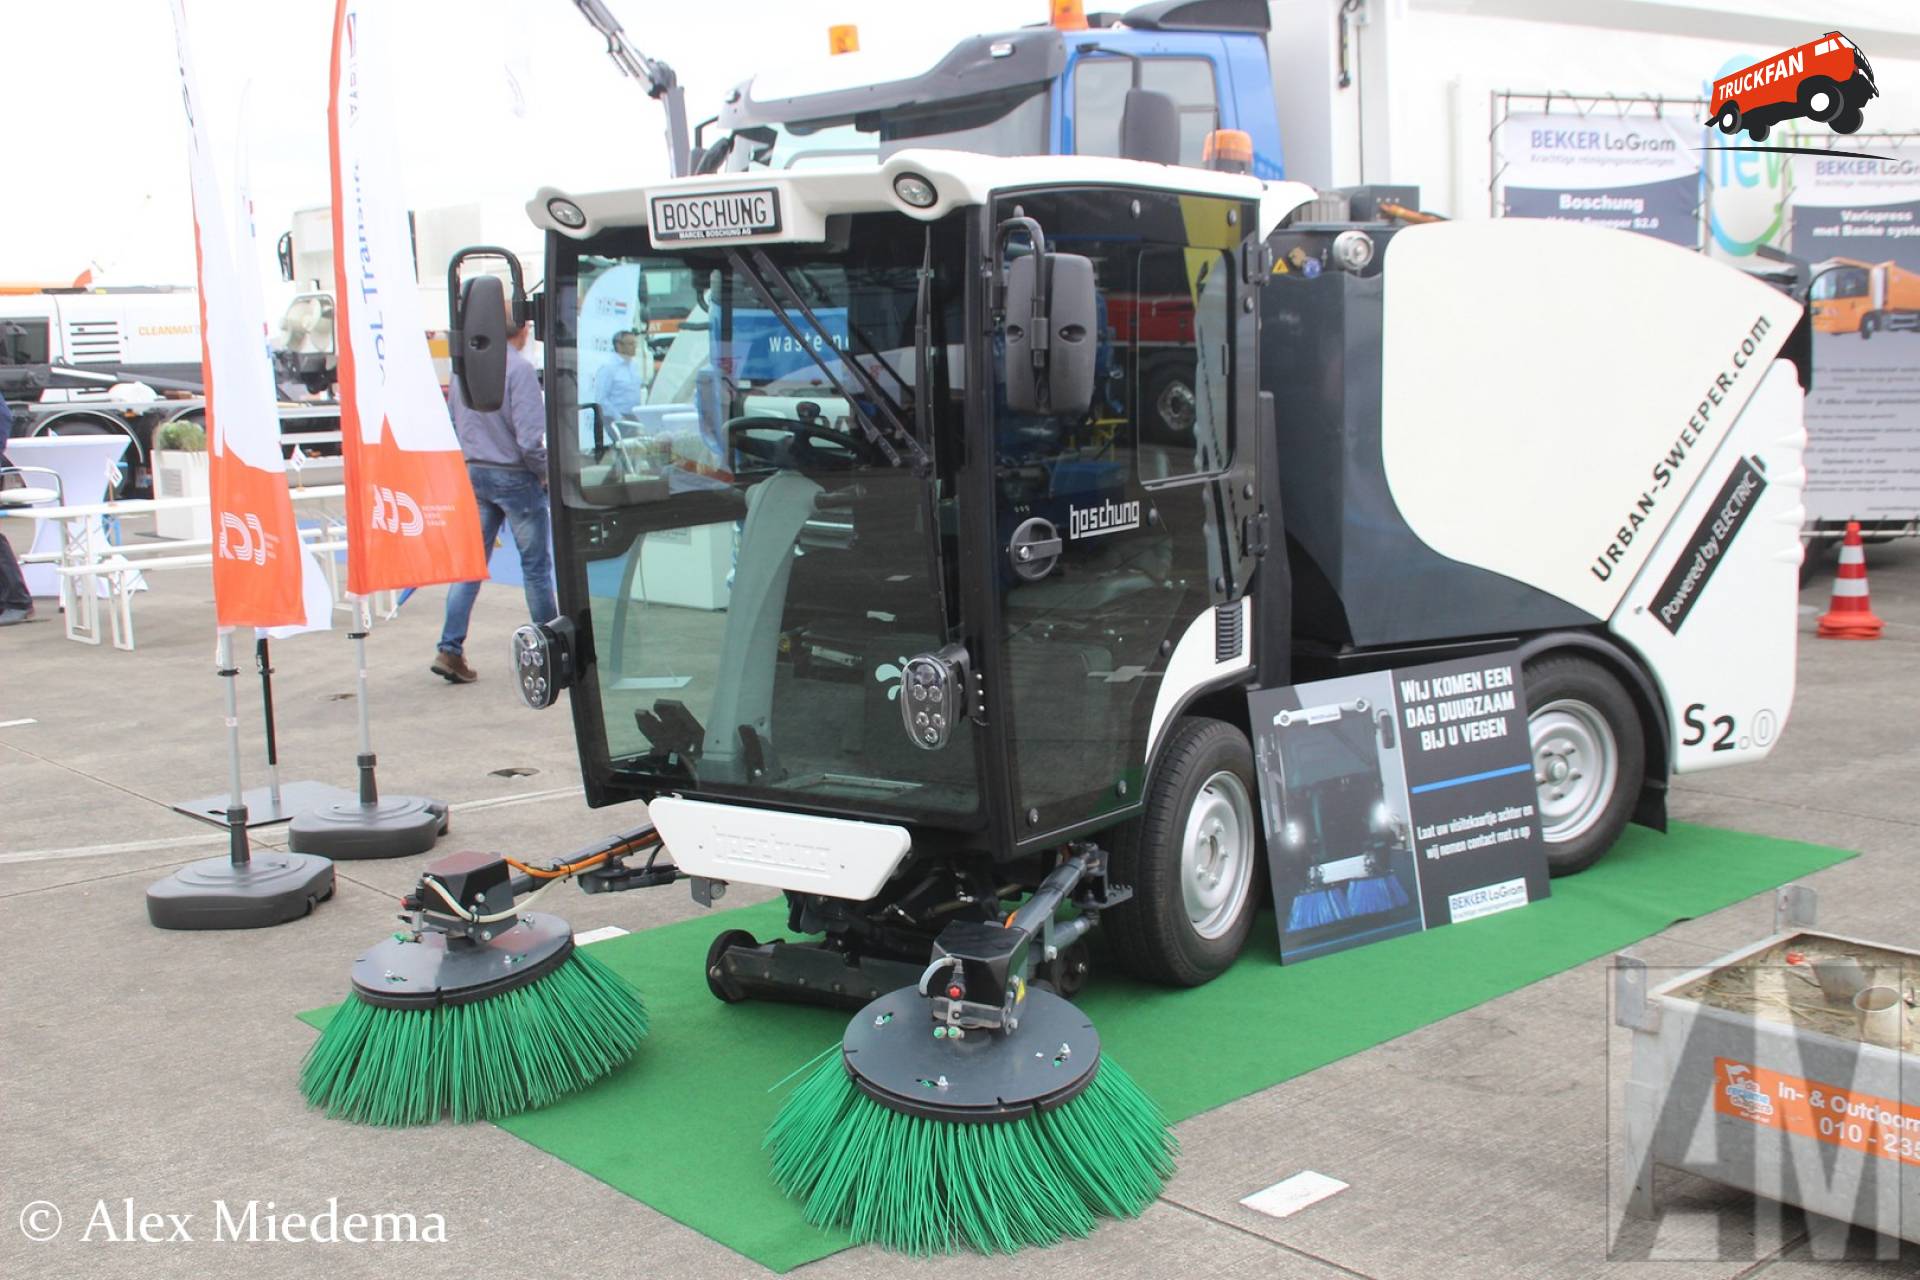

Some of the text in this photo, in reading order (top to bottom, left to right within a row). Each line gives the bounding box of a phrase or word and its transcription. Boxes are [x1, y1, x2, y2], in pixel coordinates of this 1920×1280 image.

[1605, 132, 1676, 152] LaGram
[663, 197, 767, 231] BOSCHUNG
[1559, 193, 1645, 214] Boschung
[705, 228, 741, 238] BOSCHUNG
[1632, 217, 1660, 229] S2.0
[1813, 224, 1840, 237] met
[1069, 498, 1140, 540] boschung
[1660, 470, 1758, 625] Powered by ELECTRIC
[1432, 671, 1483, 698] KOMEN
[1484, 666, 1513, 689] EEN
[1405, 690, 1516, 728] DAG DUURZAAM
[1420, 717, 1508, 751] BIJ U VEGEN
[1416, 824, 1436, 840] Laat
[1436, 824, 1449, 836] uw
[1497, 806, 1523, 822] achter
[1522, 805, 1534, 816] en
[1425, 826, 1531, 859] wij nemen contact met u op
[1778, 1081, 1805, 1101] In-
[1809, 1090, 1825, 1109] &
[1820, 1117, 1863, 1143] 010
